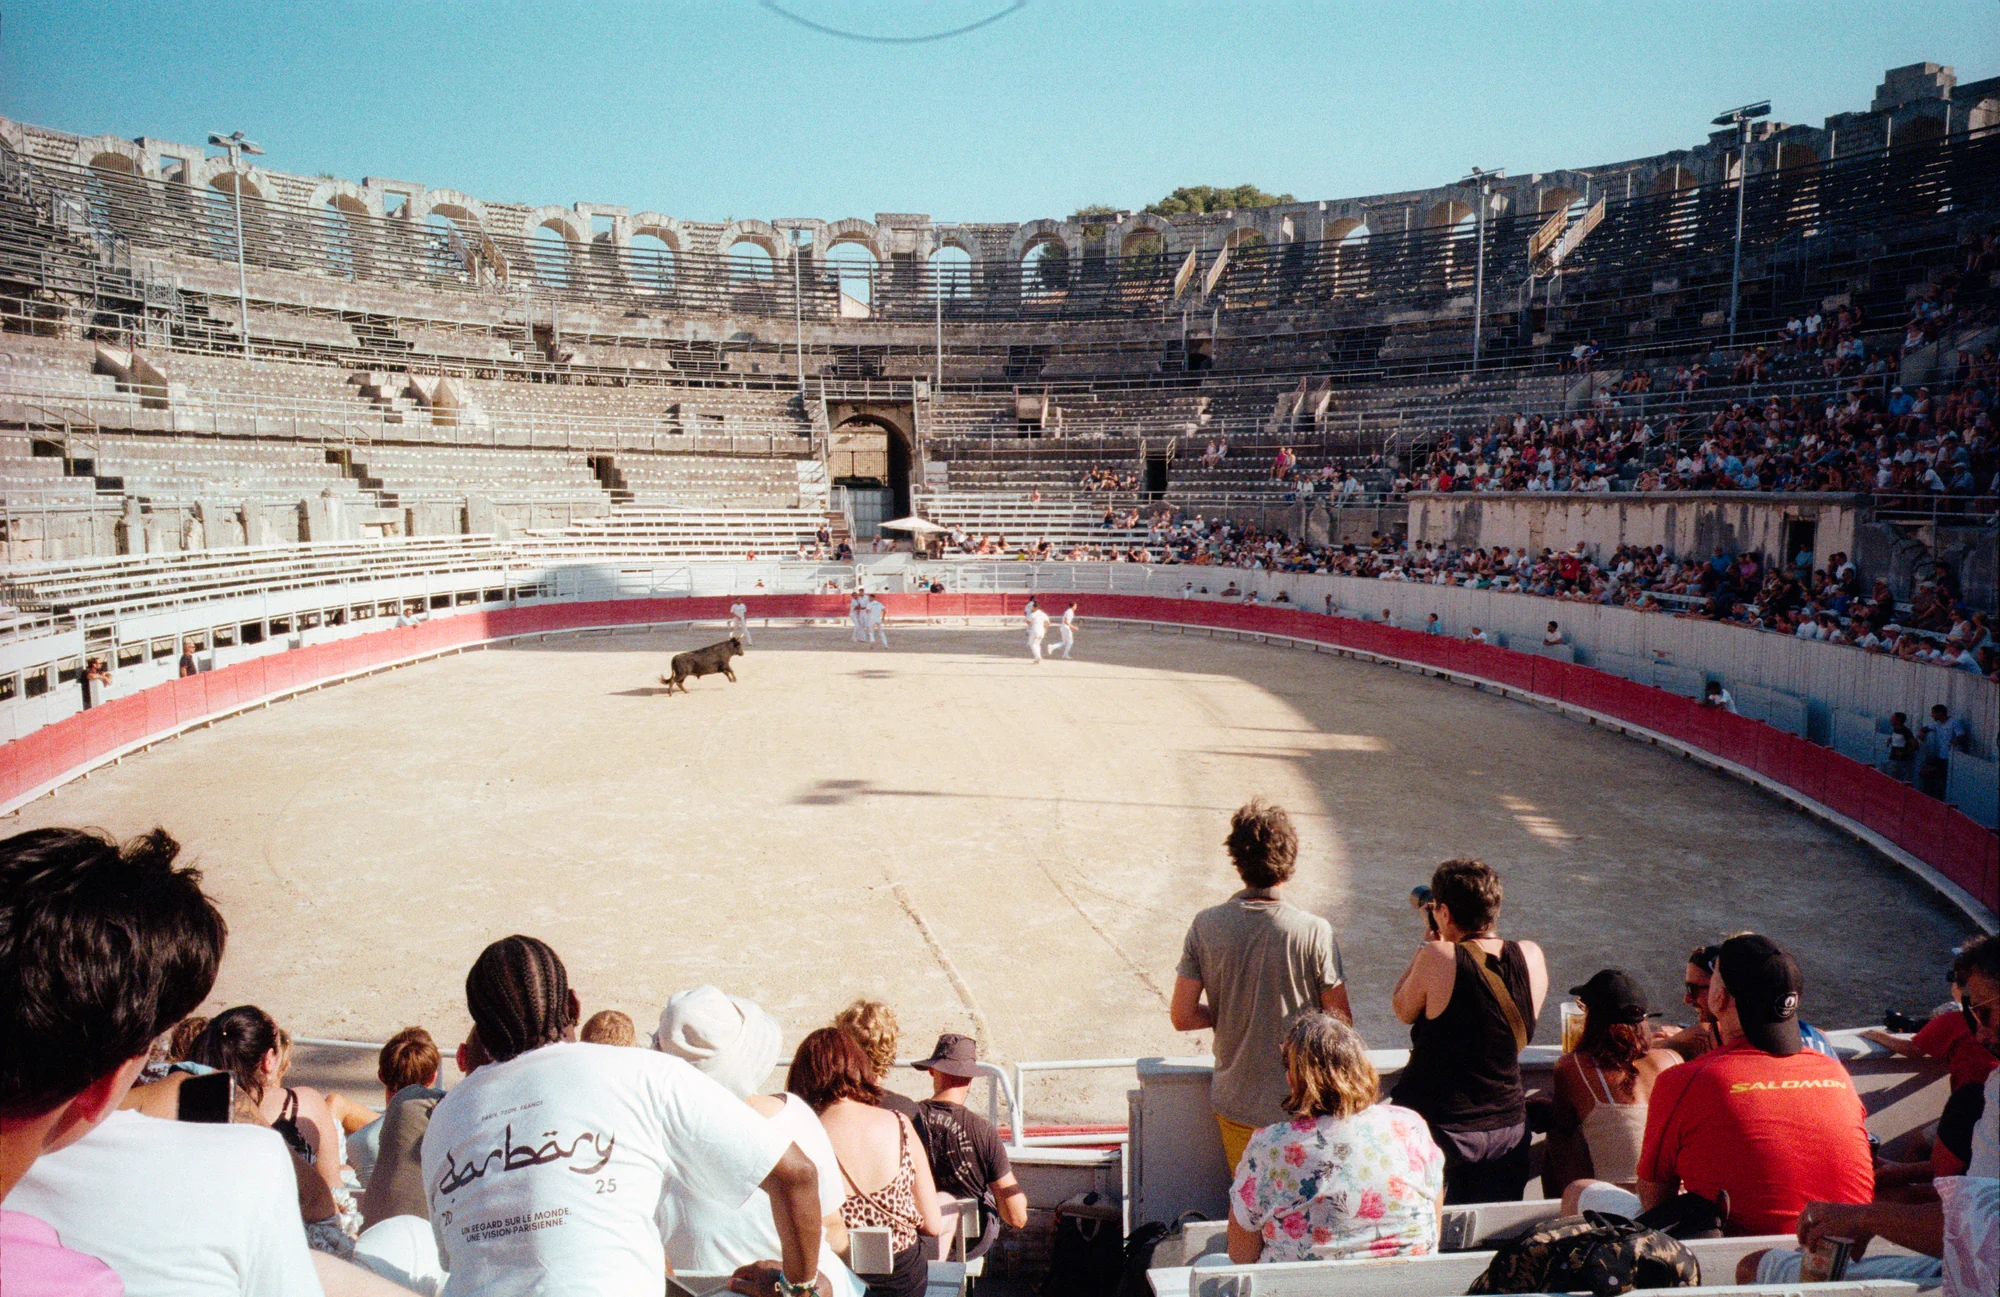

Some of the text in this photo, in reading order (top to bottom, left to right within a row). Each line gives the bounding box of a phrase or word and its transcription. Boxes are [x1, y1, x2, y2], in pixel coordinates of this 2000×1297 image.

[1729, 1079, 1846, 1093] SALOMON
[595, 1178, 617, 1194] 25
[461, 1207, 573, 1235] UN REGARD SUR LE MONDE,
[466, 1217, 567, 1243] UNE VISION PARISIENNE.
